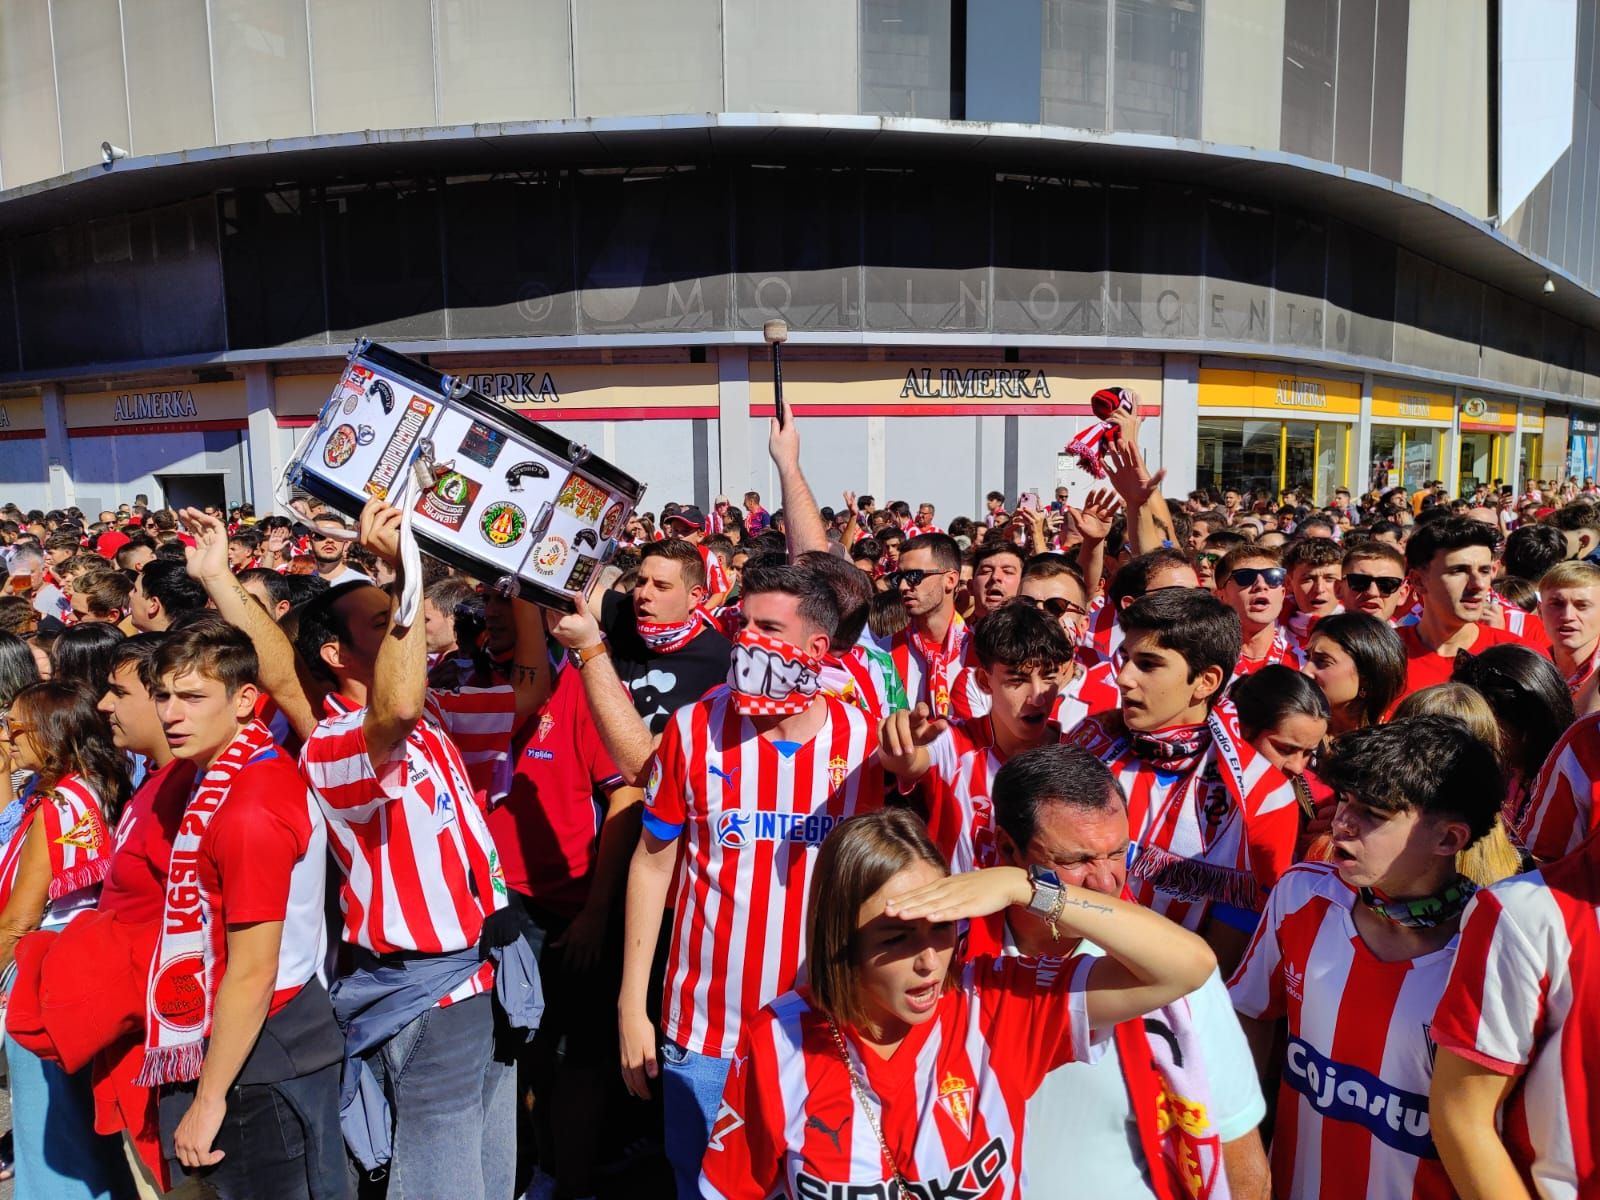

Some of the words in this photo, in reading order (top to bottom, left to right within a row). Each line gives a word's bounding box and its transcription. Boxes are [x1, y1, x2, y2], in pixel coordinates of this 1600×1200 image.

[898, 367, 1051, 399] ALIMERKA
[1274, 379, 1328, 408] ALIMERKA
[114, 391, 198, 421] ALIMERKA
[422, 502, 459, 524] SIEMPRE
[755, 811, 848, 842] INTEGR
[1287, 1041, 1431, 1138] Cajastu
